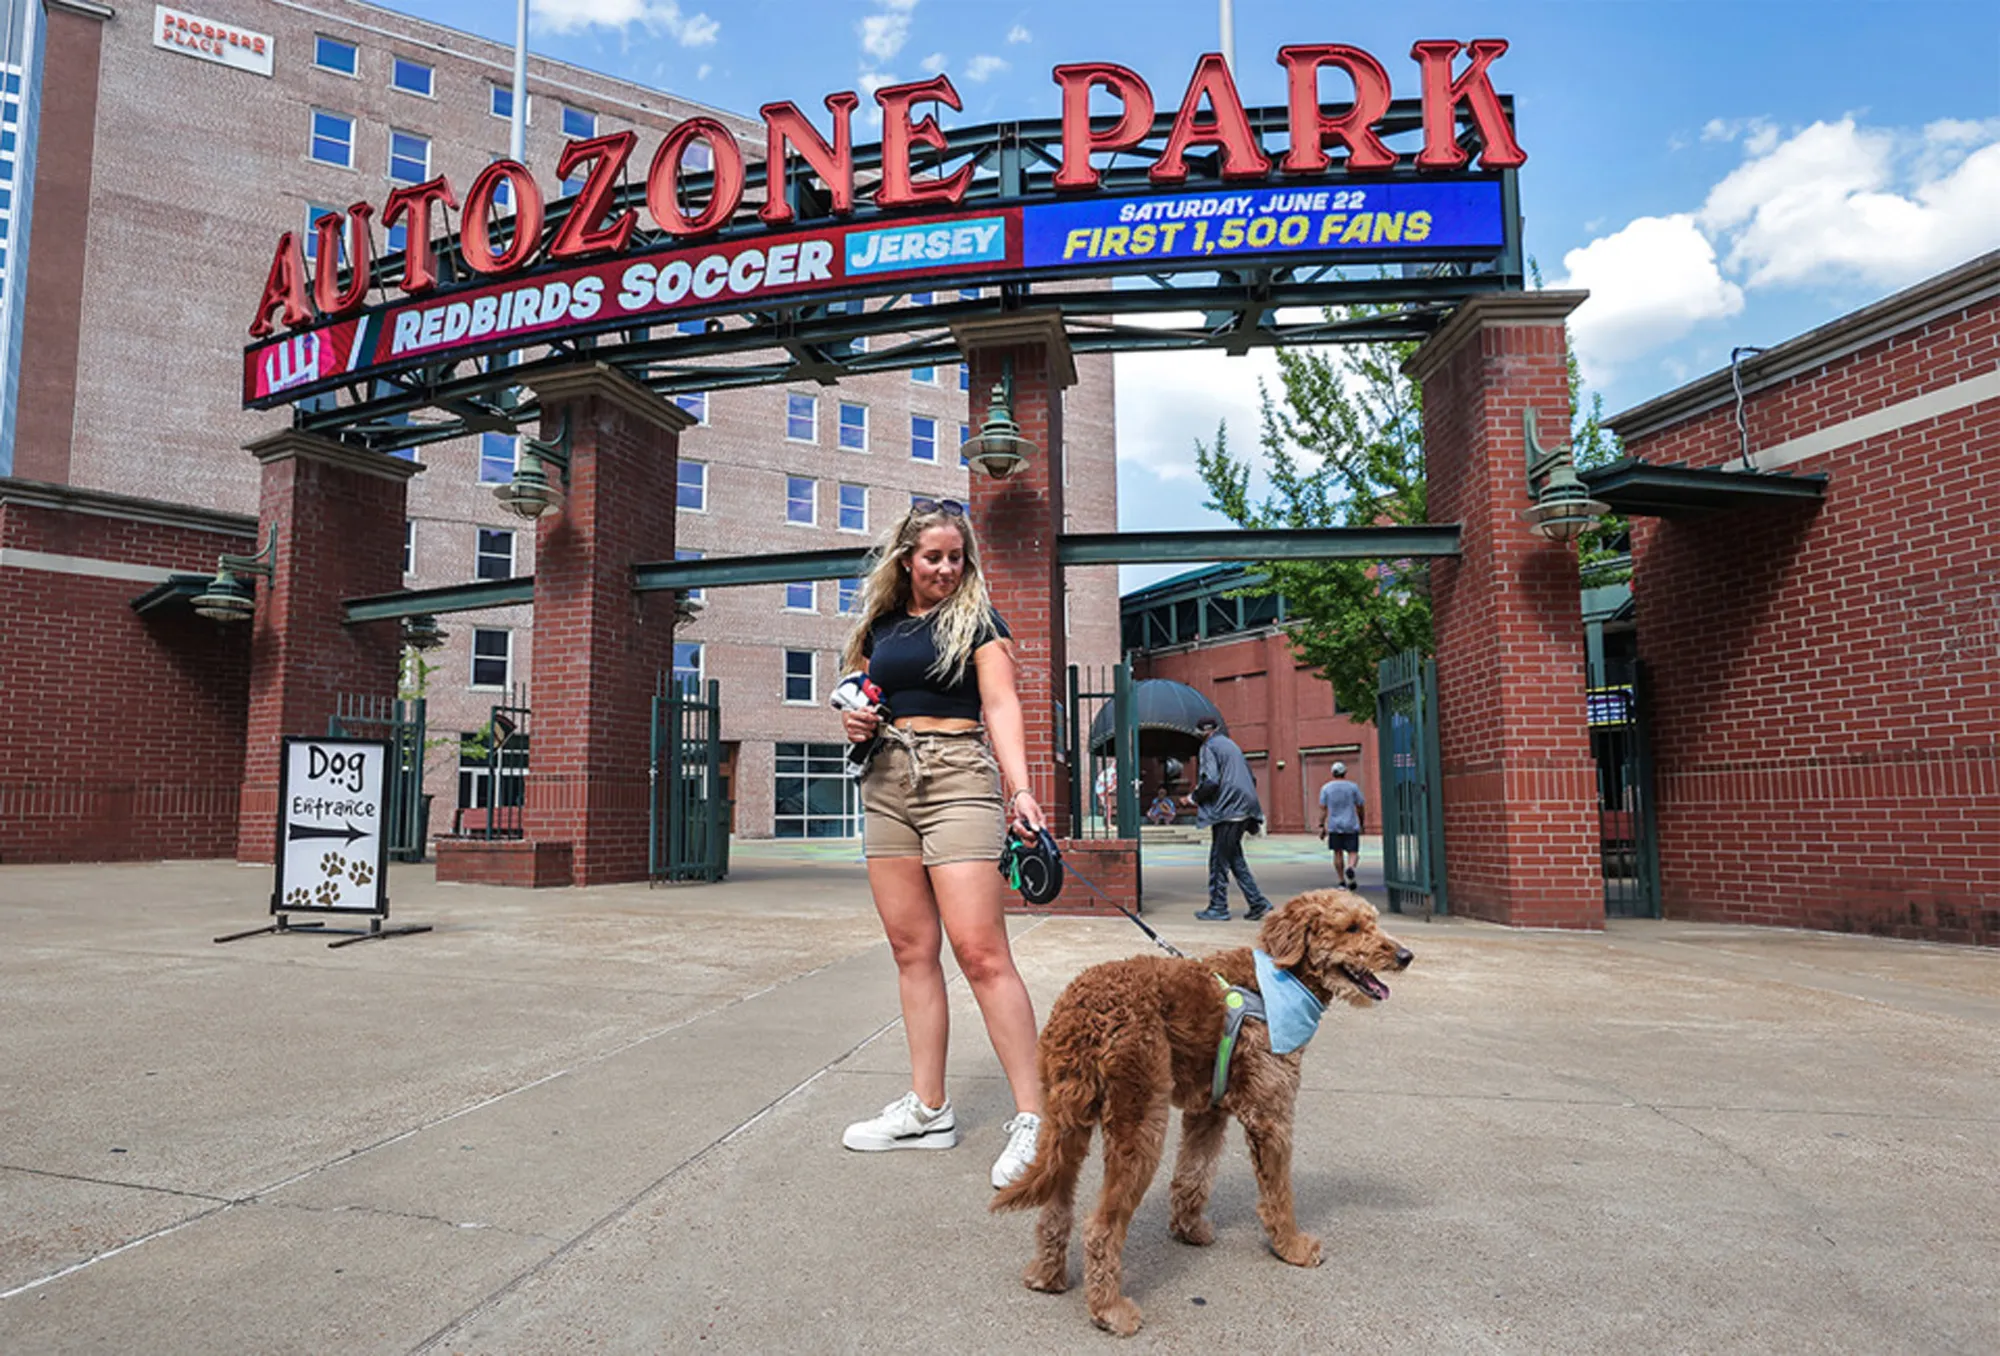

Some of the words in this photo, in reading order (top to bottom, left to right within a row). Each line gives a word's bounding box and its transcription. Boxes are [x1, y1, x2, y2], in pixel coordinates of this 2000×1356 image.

[163, 28, 224, 56] PLACE
[249, 73, 975, 337] AUTOZONE
[1052, 39, 1527, 192] PARK
[1120, 195, 1256, 223] SATURDAY,
[1259, 193, 1328, 214] JUNE
[1333, 190, 1367, 212] 22
[1062, 224, 1187, 262] FIRST
[1192, 219, 1310, 256] 1,500
[1318, 210, 1433, 246] FANS
[391, 276, 605, 355] REDBIRDS
[617, 240, 834, 311] SOCCER
[851, 225, 999, 268] JERSEY
[308, 745, 366, 793] Dog
[293, 796, 375, 820] Entrance
